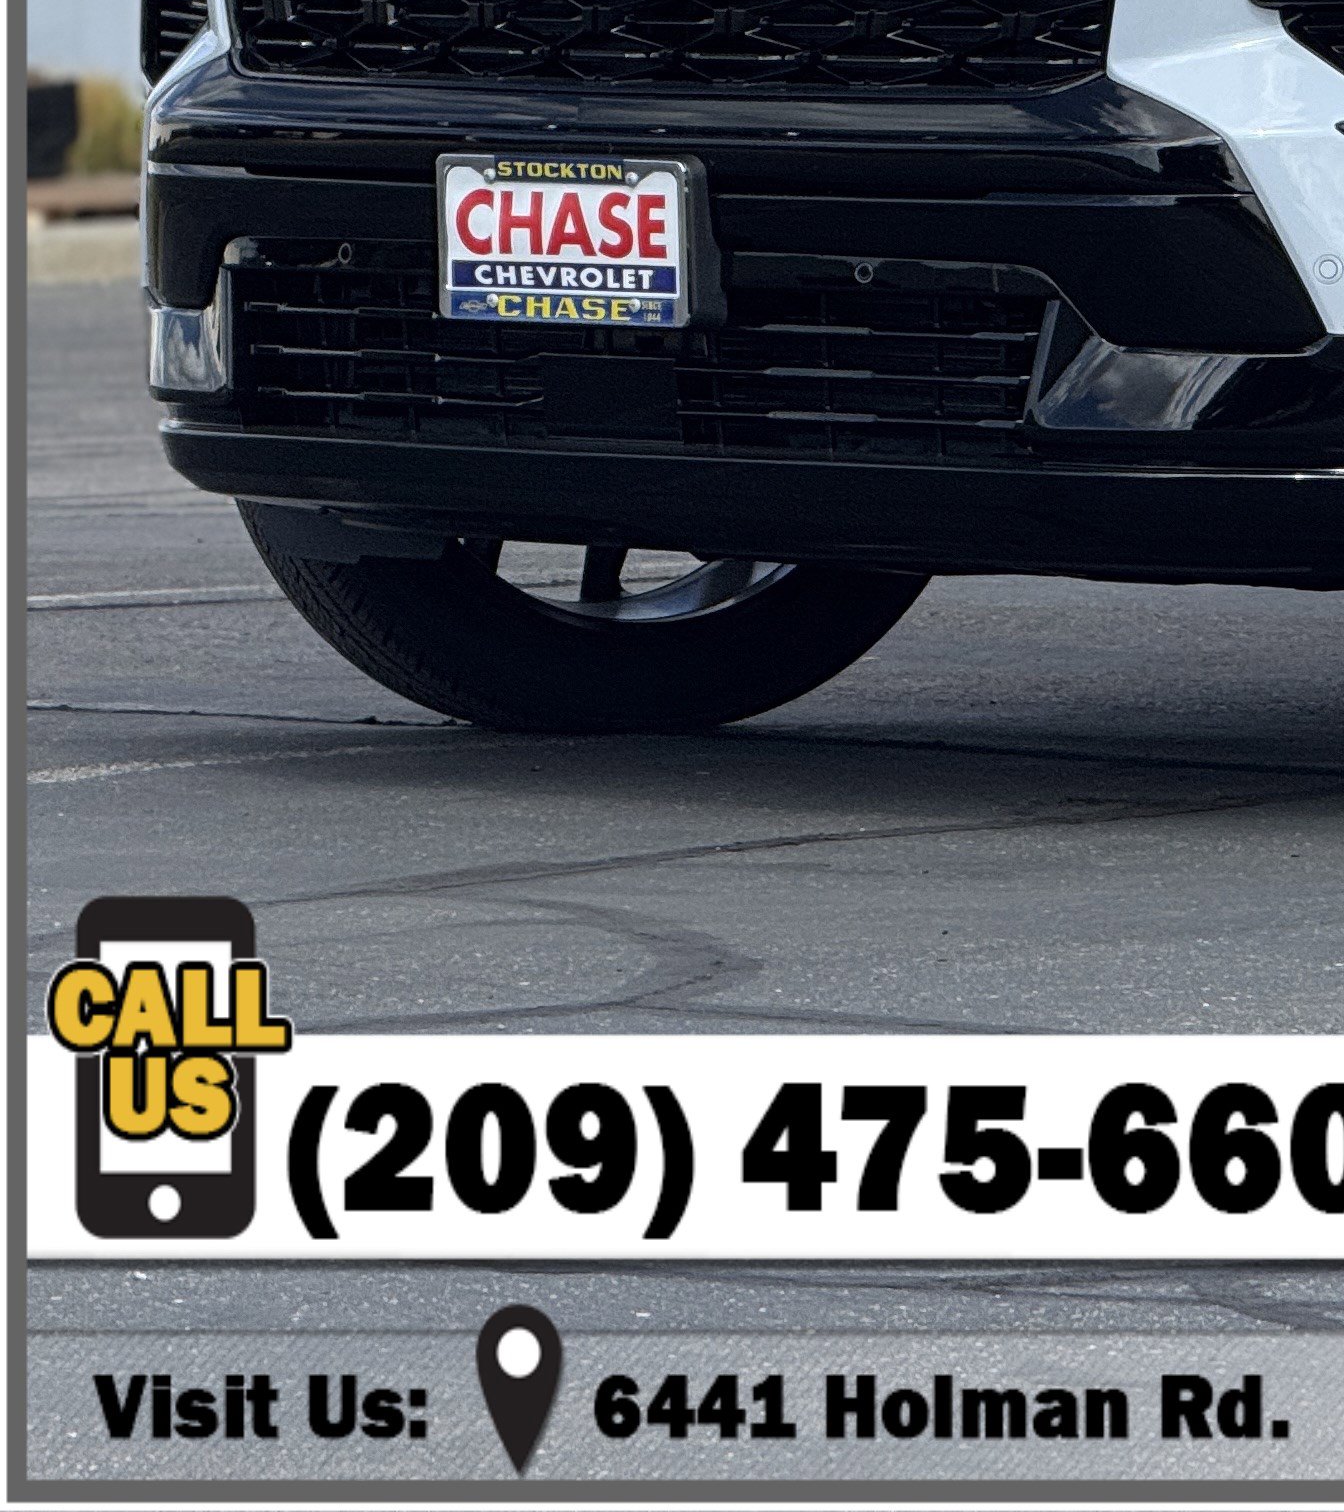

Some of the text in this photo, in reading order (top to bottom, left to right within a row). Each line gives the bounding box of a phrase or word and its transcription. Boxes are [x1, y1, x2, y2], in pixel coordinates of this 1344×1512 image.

[497, 161, 624, 180] STOCKTON
[456, 188, 668, 259] CHASE
[474, 264, 654, 290] CHEVROLET
[497, 295, 631, 321] CHASE
